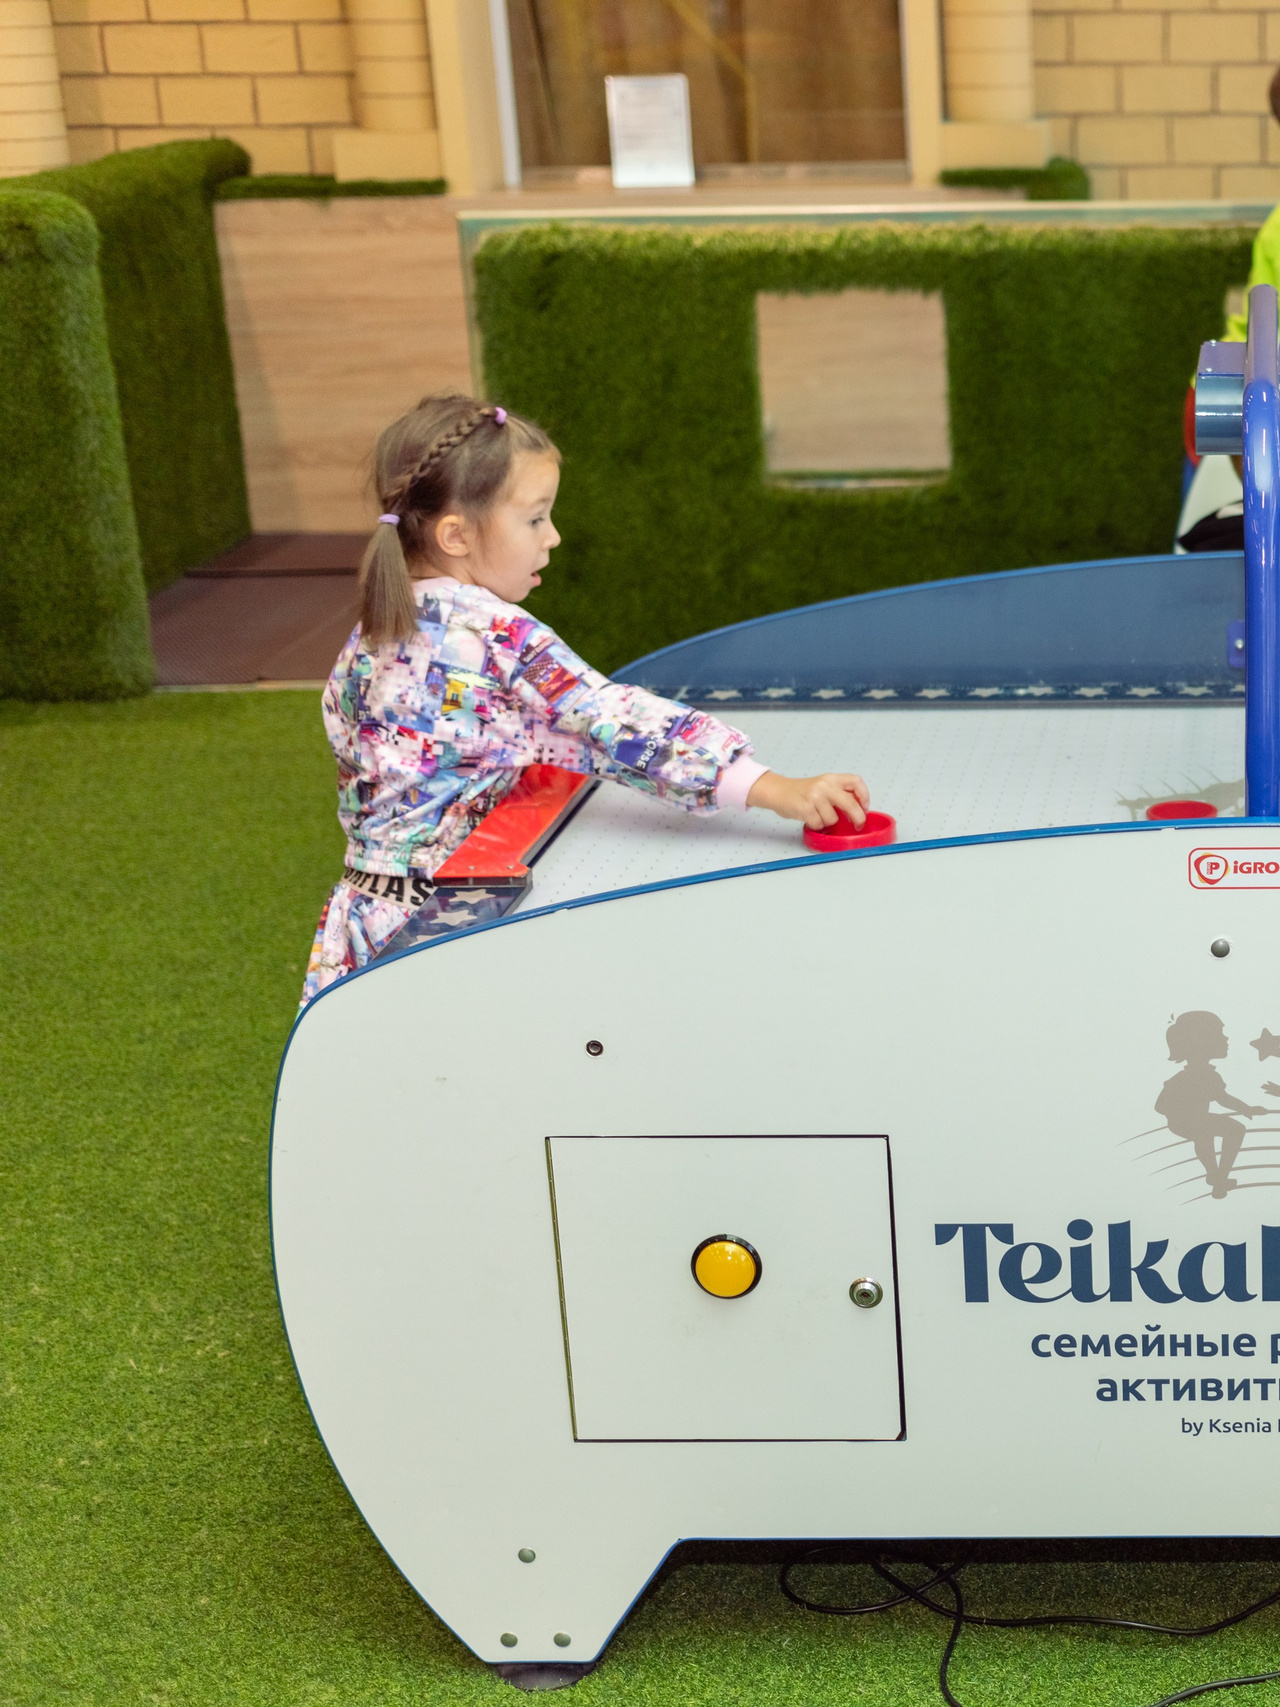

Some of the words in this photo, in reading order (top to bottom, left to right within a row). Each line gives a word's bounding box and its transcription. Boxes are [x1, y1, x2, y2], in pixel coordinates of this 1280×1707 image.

[1030, 1324, 1257, 1358] семейные
[1180, 1417, 1204, 1437] by
[1209, 1417, 1273, 1434] Ksenia
